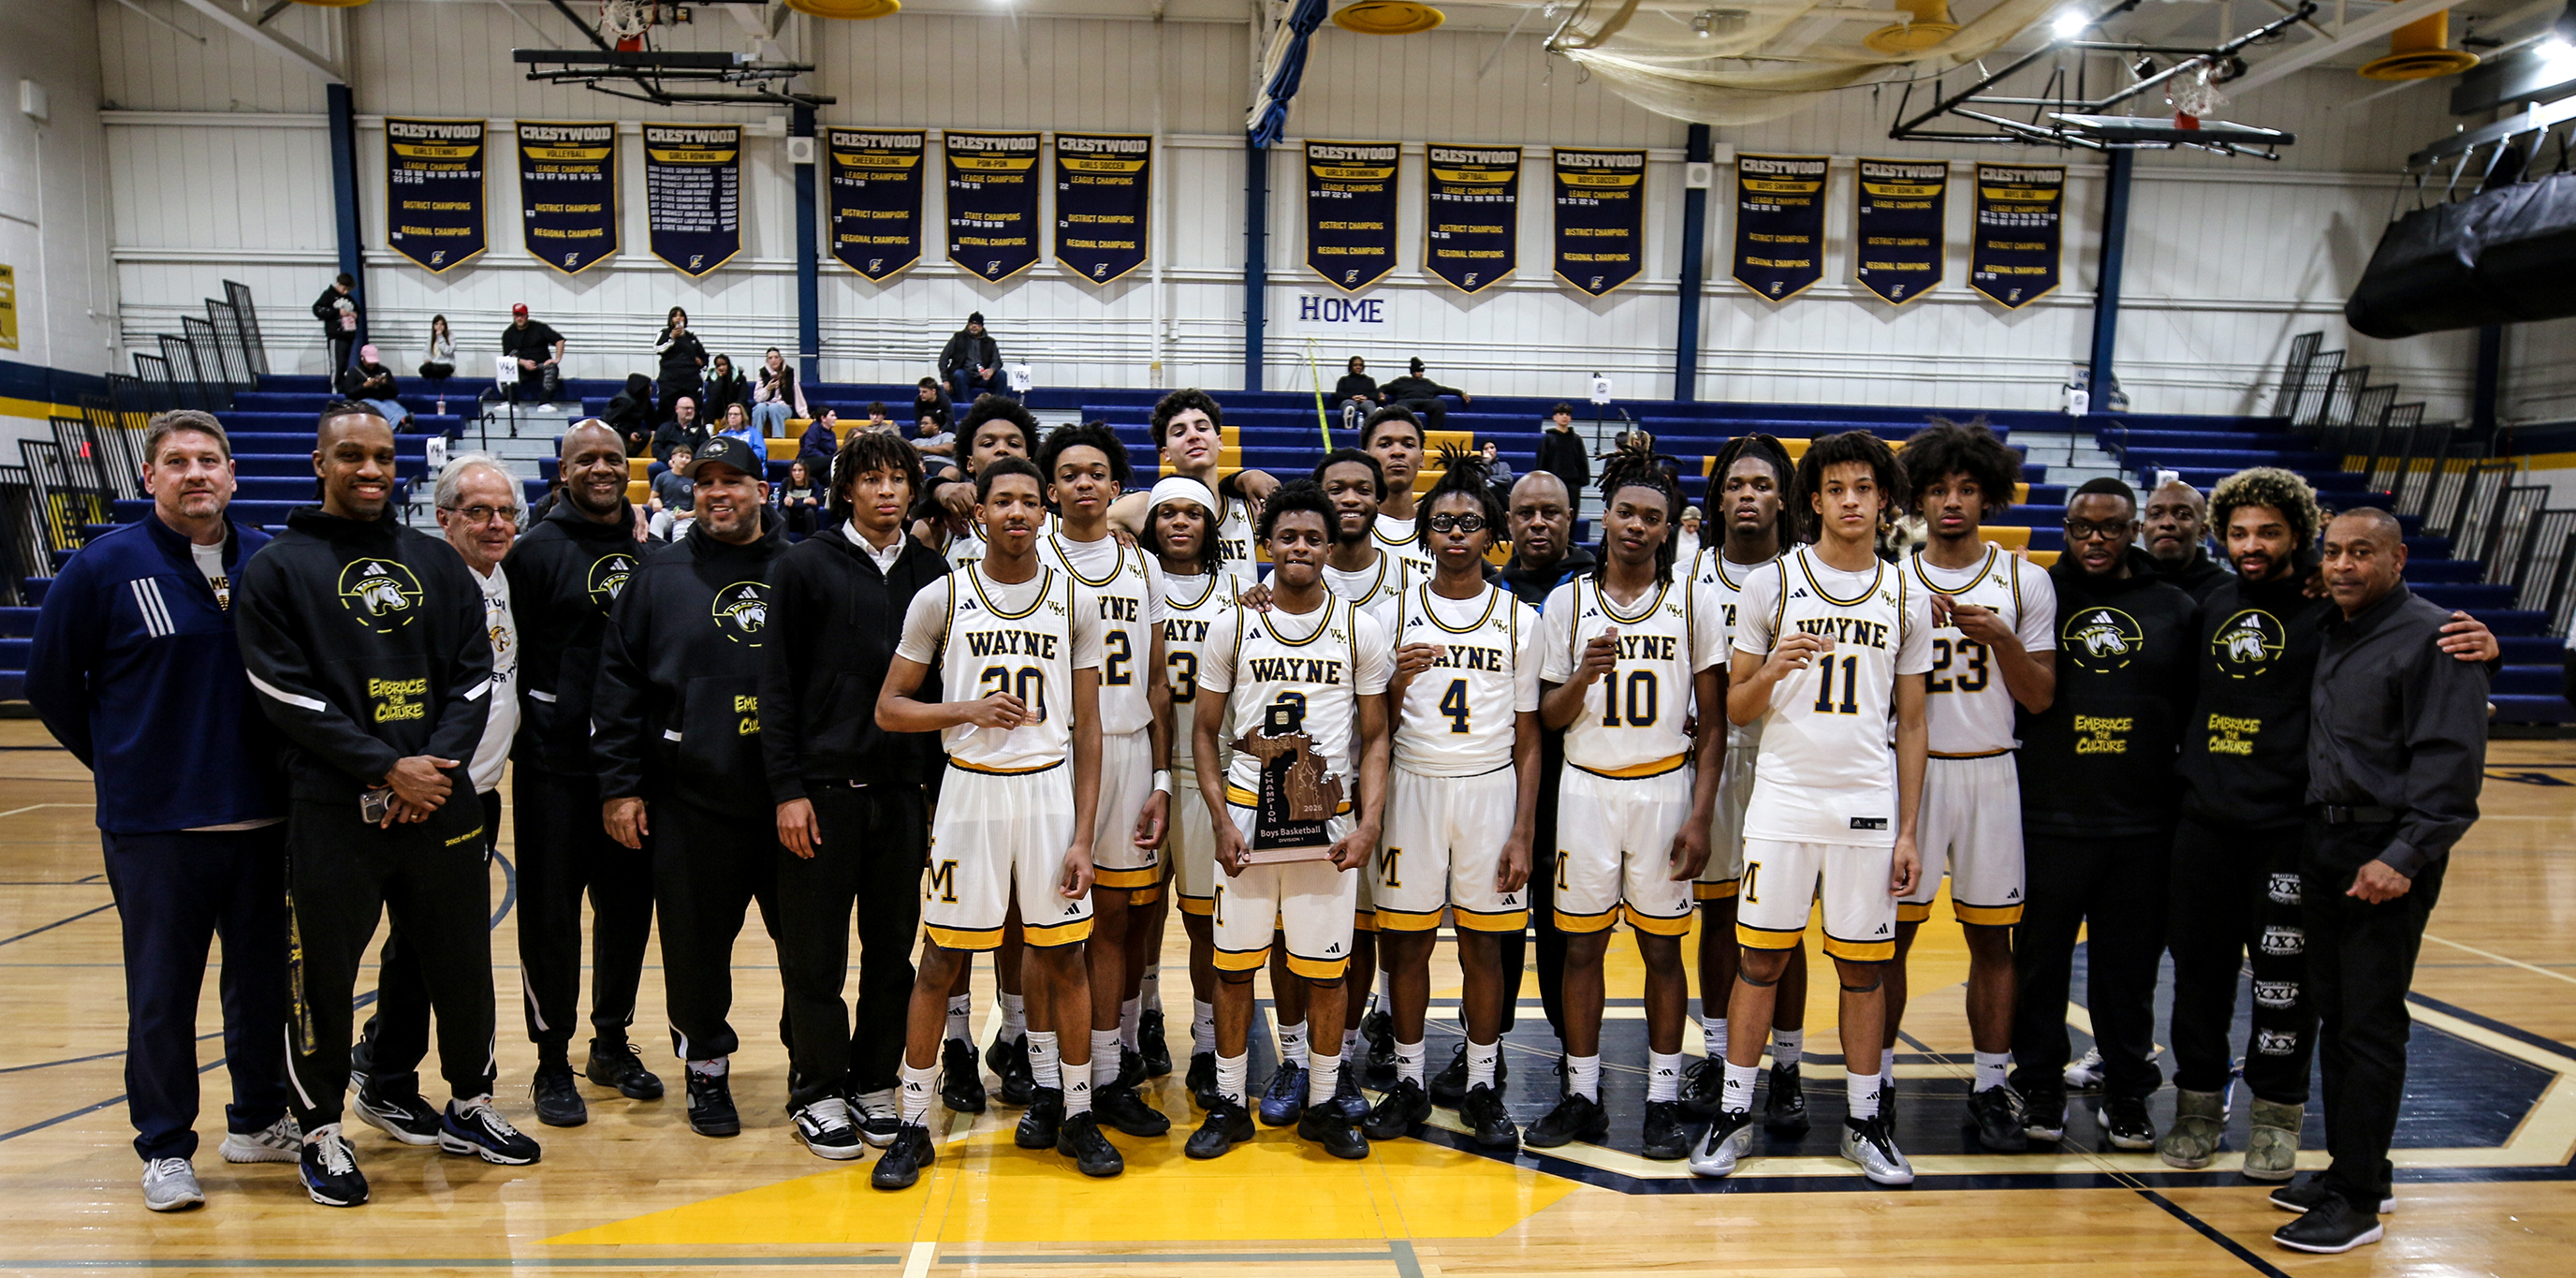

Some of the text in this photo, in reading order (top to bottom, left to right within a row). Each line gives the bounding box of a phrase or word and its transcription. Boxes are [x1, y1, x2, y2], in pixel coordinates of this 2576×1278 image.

[389, 123, 481, 139] CRESTWOOD
[520, 125, 611, 140] CRESTWOOD
[647, 128, 737, 142] CRESTWOOD
[832, 132, 921, 148] CRESTWOOD
[947, 136, 1037, 150] CRESTWOOD
[1058, 138, 1148, 153] CRESTWOOD
[413, 146, 432, 154] GIRLS
[1309, 145, 1397, 160] CRESTWOOD
[1430, 149, 1517, 163] CRESTWOOD
[403, 161, 428, 170] LEAGUE
[852, 156, 900, 165] CHEERLEADING
[1557, 153, 1643, 167] CRESTWOOD
[1741, 159, 1825, 173] CRESTWOOD
[845, 171, 908, 181] LEAGUE CHAMPIONS
[1862, 163, 1944, 177] CRESTWOOD
[1980, 168, 2062, 182] CRESTWOOD
[960, 174, 985, 183] LEAGUE
[1071, 175, 1134, 185] LEAGUE CHAMPIONS
[1346, 184, 1383, 192] CHAMPIONS
[1442, 186, 1466, 195] LEAGUE
[1569, 190, 1592, 198] LEAGUE
[402, 200, 471, 210] DISTRICT CHAMPIONS
[535, 203, 601, 213] DISTRICT CHAMPIONS
[842, 208, 909, 219] DISTRICT CHAMPIONS
[964, 212, 983, 220] STATE
[1068, 213, 1097, 223] DISTRICT
[401, 225, 471, 236] REGIONAL CHAMPIONS
[1319, 221, 1347, 229] DISTRICT
[1439, 224, 1467, 232] DISTRICT
[534, 228, 603, 238] REGIONAL CHAMPIONS
[841, 234, 910, 244] REGIONAL CHAMPIONS
[1565, 228, 1629, 237] DISTRICT CHAMPIONS
[959, 237, 988, 245] NATIONAL
[1066, 239, 1135, 249] REGIONAL CHAMPIONS
[1318, 246, 1348, 255] REGIONAL
[1437, 249, 1504, 258] REGIONAL CHAMPIONS
[1563, 253, 1593, 261] REGIONAL
[1299, 294, 1384, 323] HOME
[1796, 617, 1888, 650] WAYNE
[965, 630, 1058, 660] WAYNE
[1249, 657, 1342, 684] WAYNE
[1925, 637, 1990, 694] 23
[368, 678, 427, 699] EMBRACE
[1814, 653, 1859, 715] 11
[1603, 668, 1659, 728] 10
[374, 702, 425, 723] CULTURE
[1439, 678, 1471, 734] 4
[2074, 714, 2133, 731] EMBRACE
[2207, 713, 2261, 733] EMBRACE
[2075, 737, 2127, 755] CULTURE
[2208, 735, 2254, 755] CULTURE
[1265, 771, 1277, 823] CHAMPION
[1261, 826, 1321, 839] Boys Basketball
